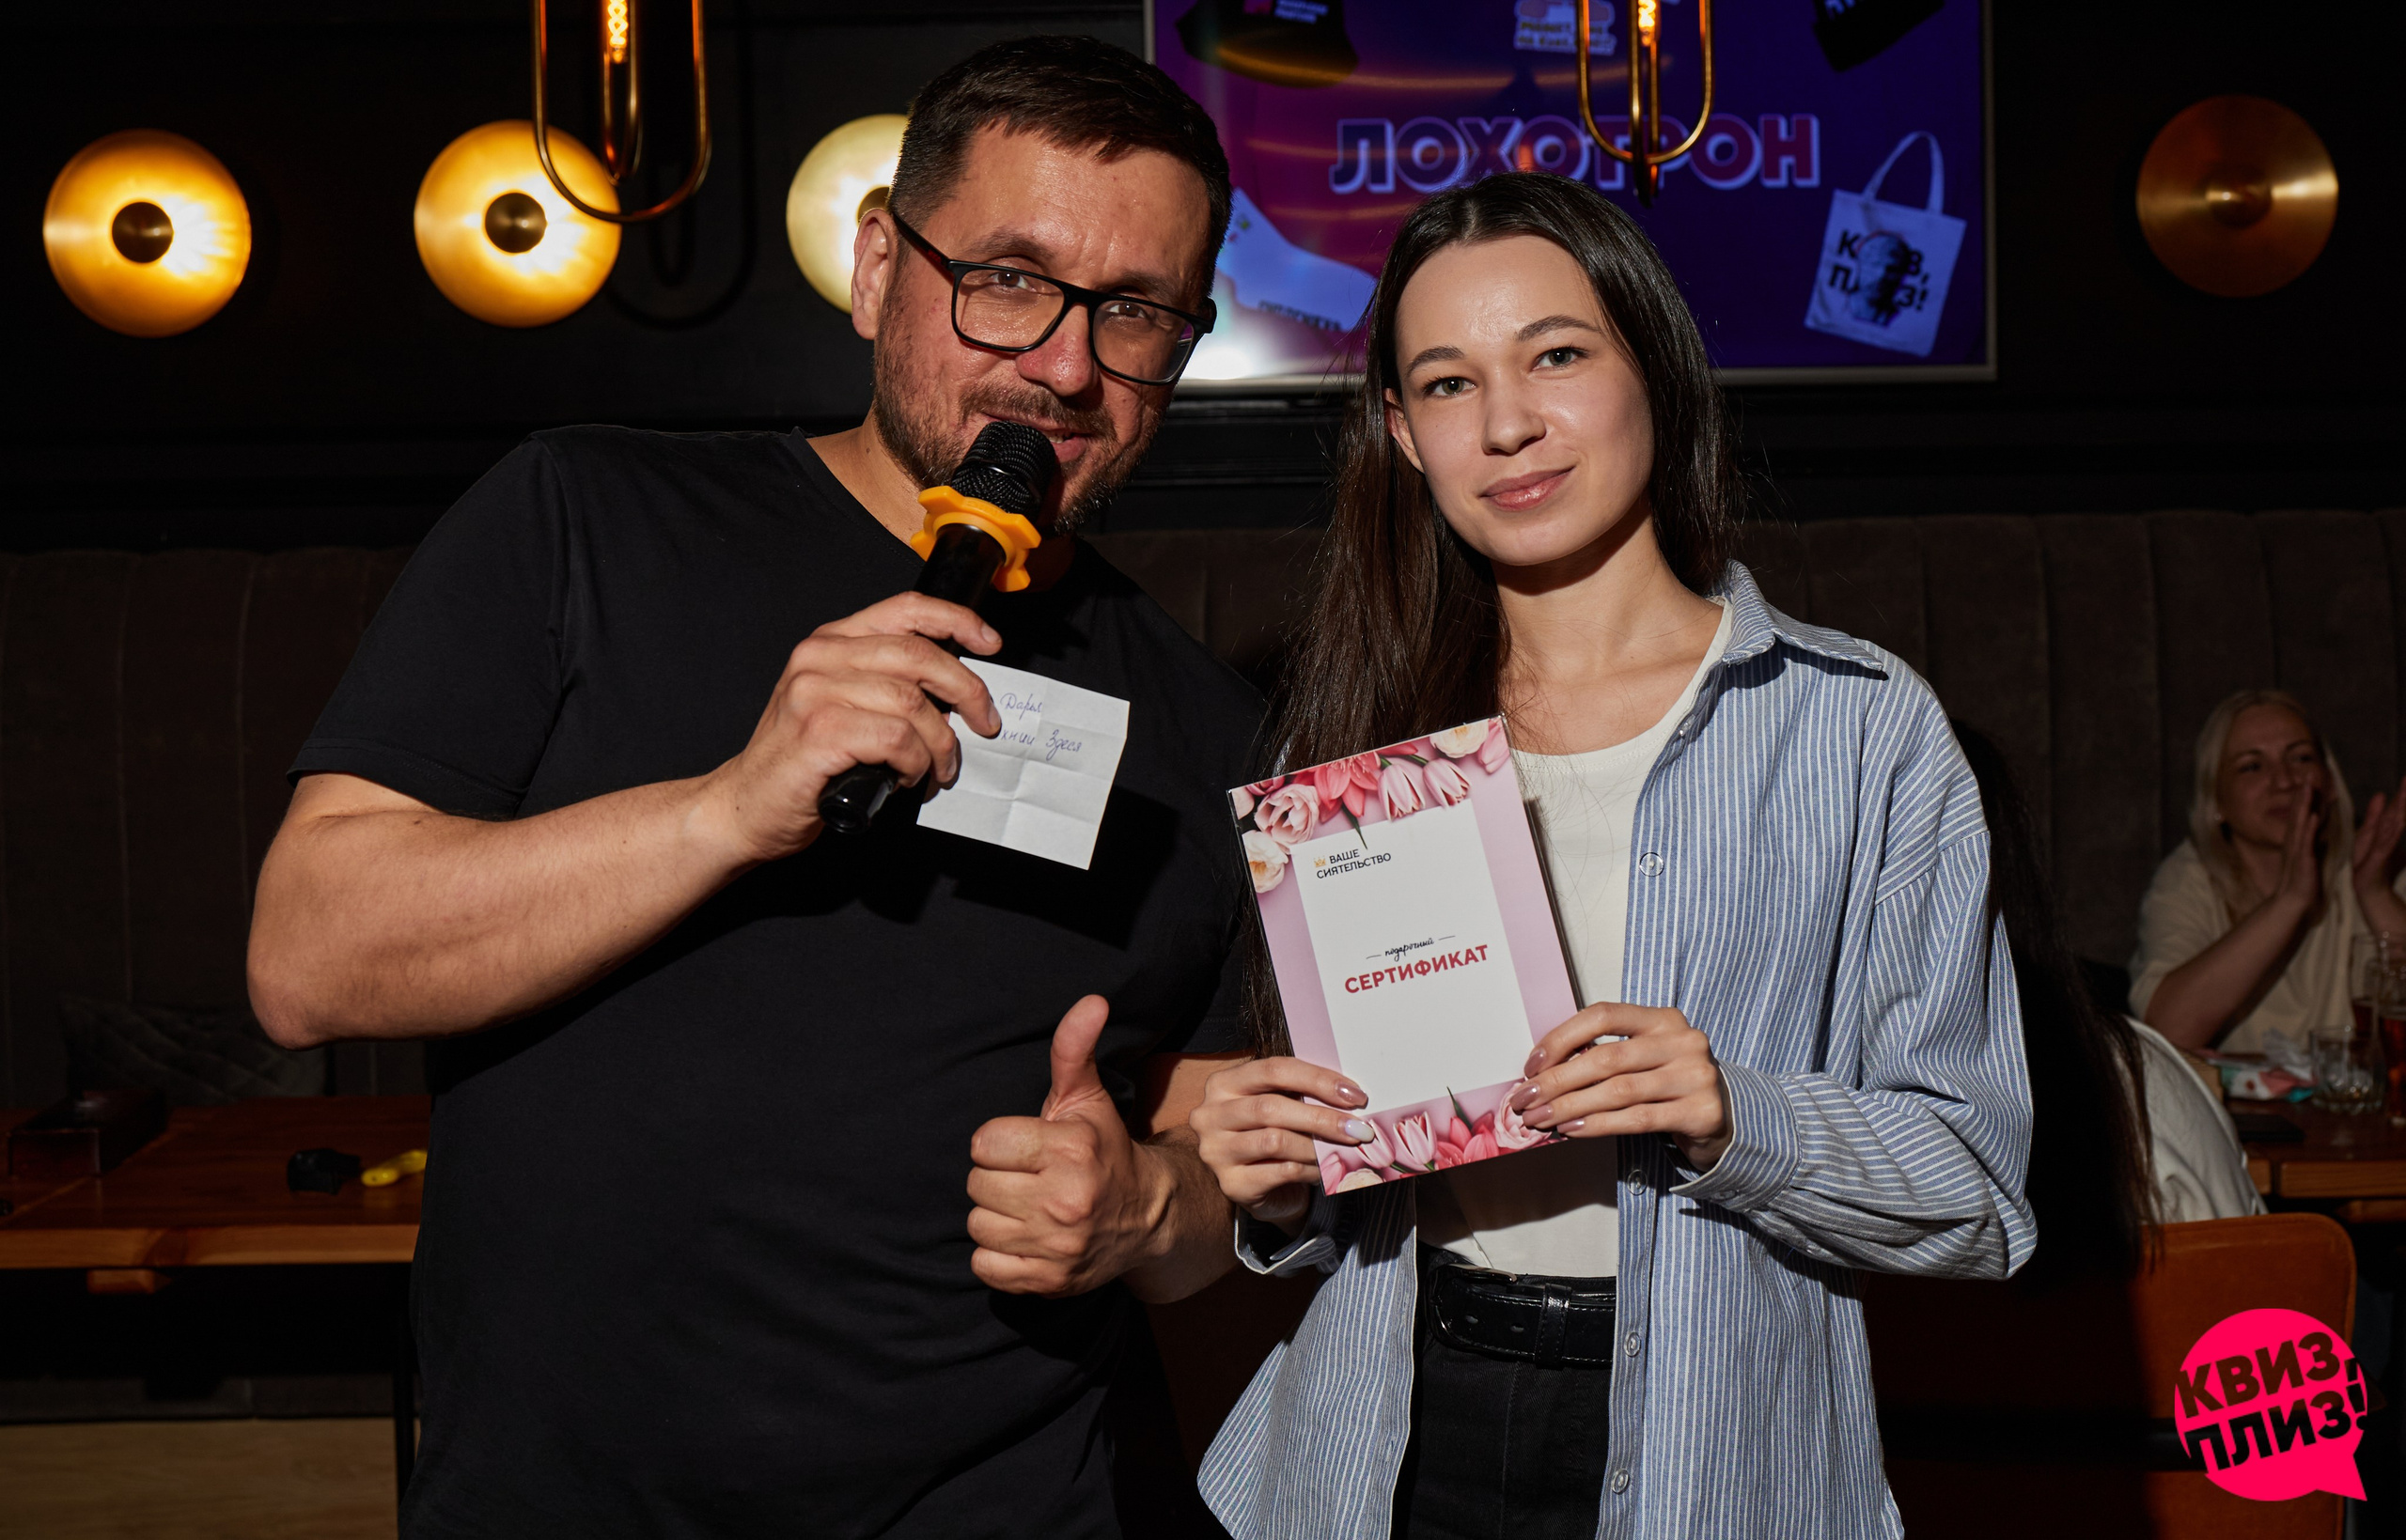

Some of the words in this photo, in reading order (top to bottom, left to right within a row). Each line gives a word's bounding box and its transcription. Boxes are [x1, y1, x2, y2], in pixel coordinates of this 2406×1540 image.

[1316, 852, 1392, 879] СИЯТЕЛЬСТВО
[1329, 848, 1360, 864] ВАШЕ
[1384, 937, 1434, 962] подарочный
[1344, 943, 1489, 994] СЕРТИФИКАТ
